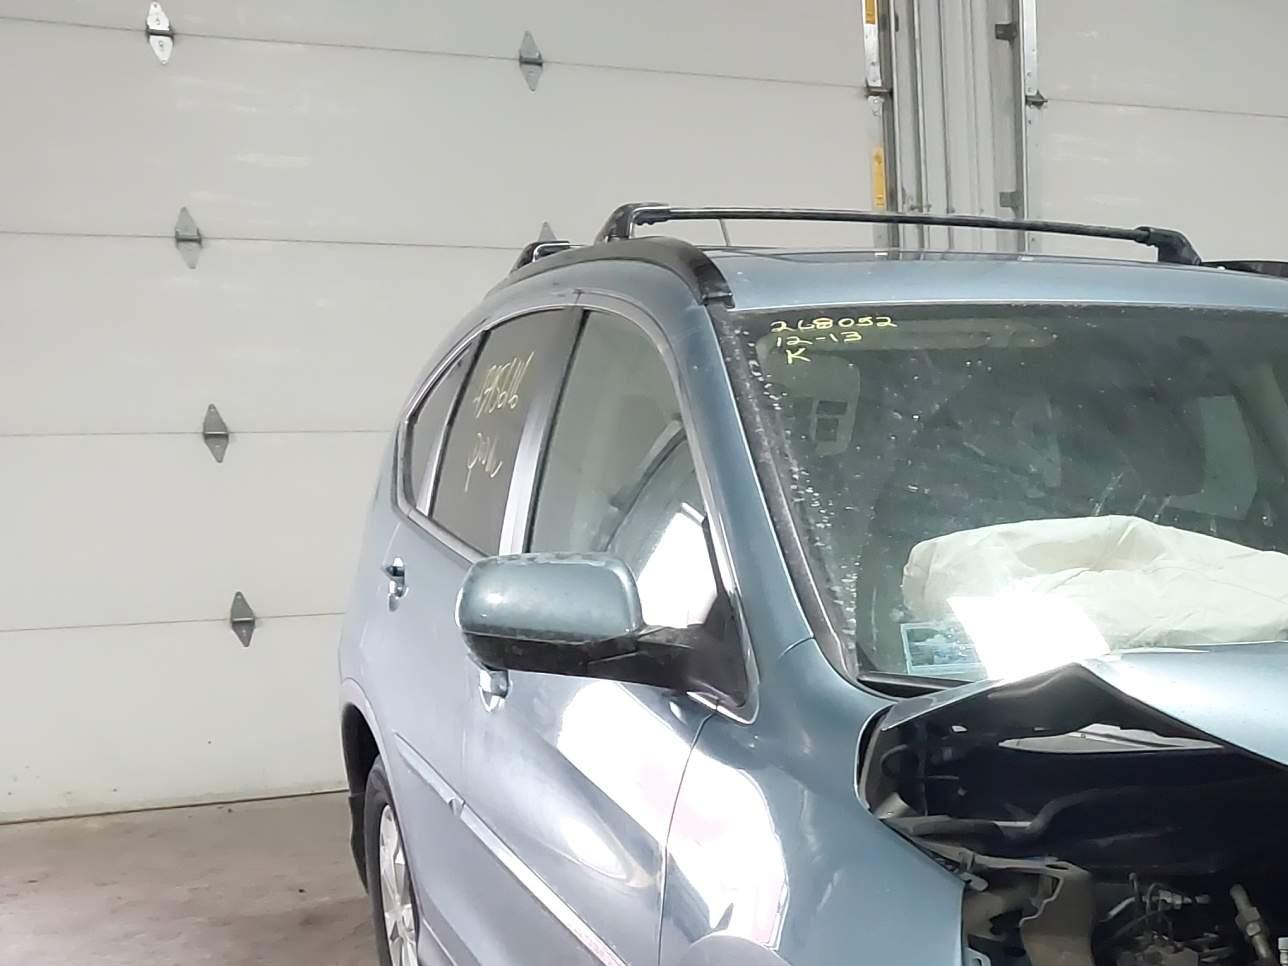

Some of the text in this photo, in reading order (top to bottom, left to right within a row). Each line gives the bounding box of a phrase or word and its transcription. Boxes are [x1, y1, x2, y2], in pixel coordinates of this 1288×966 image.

[770, 315, 898, 333] 268052
[776, 331, 863, 348] 12-13
[785, 347, 812, 365] K
